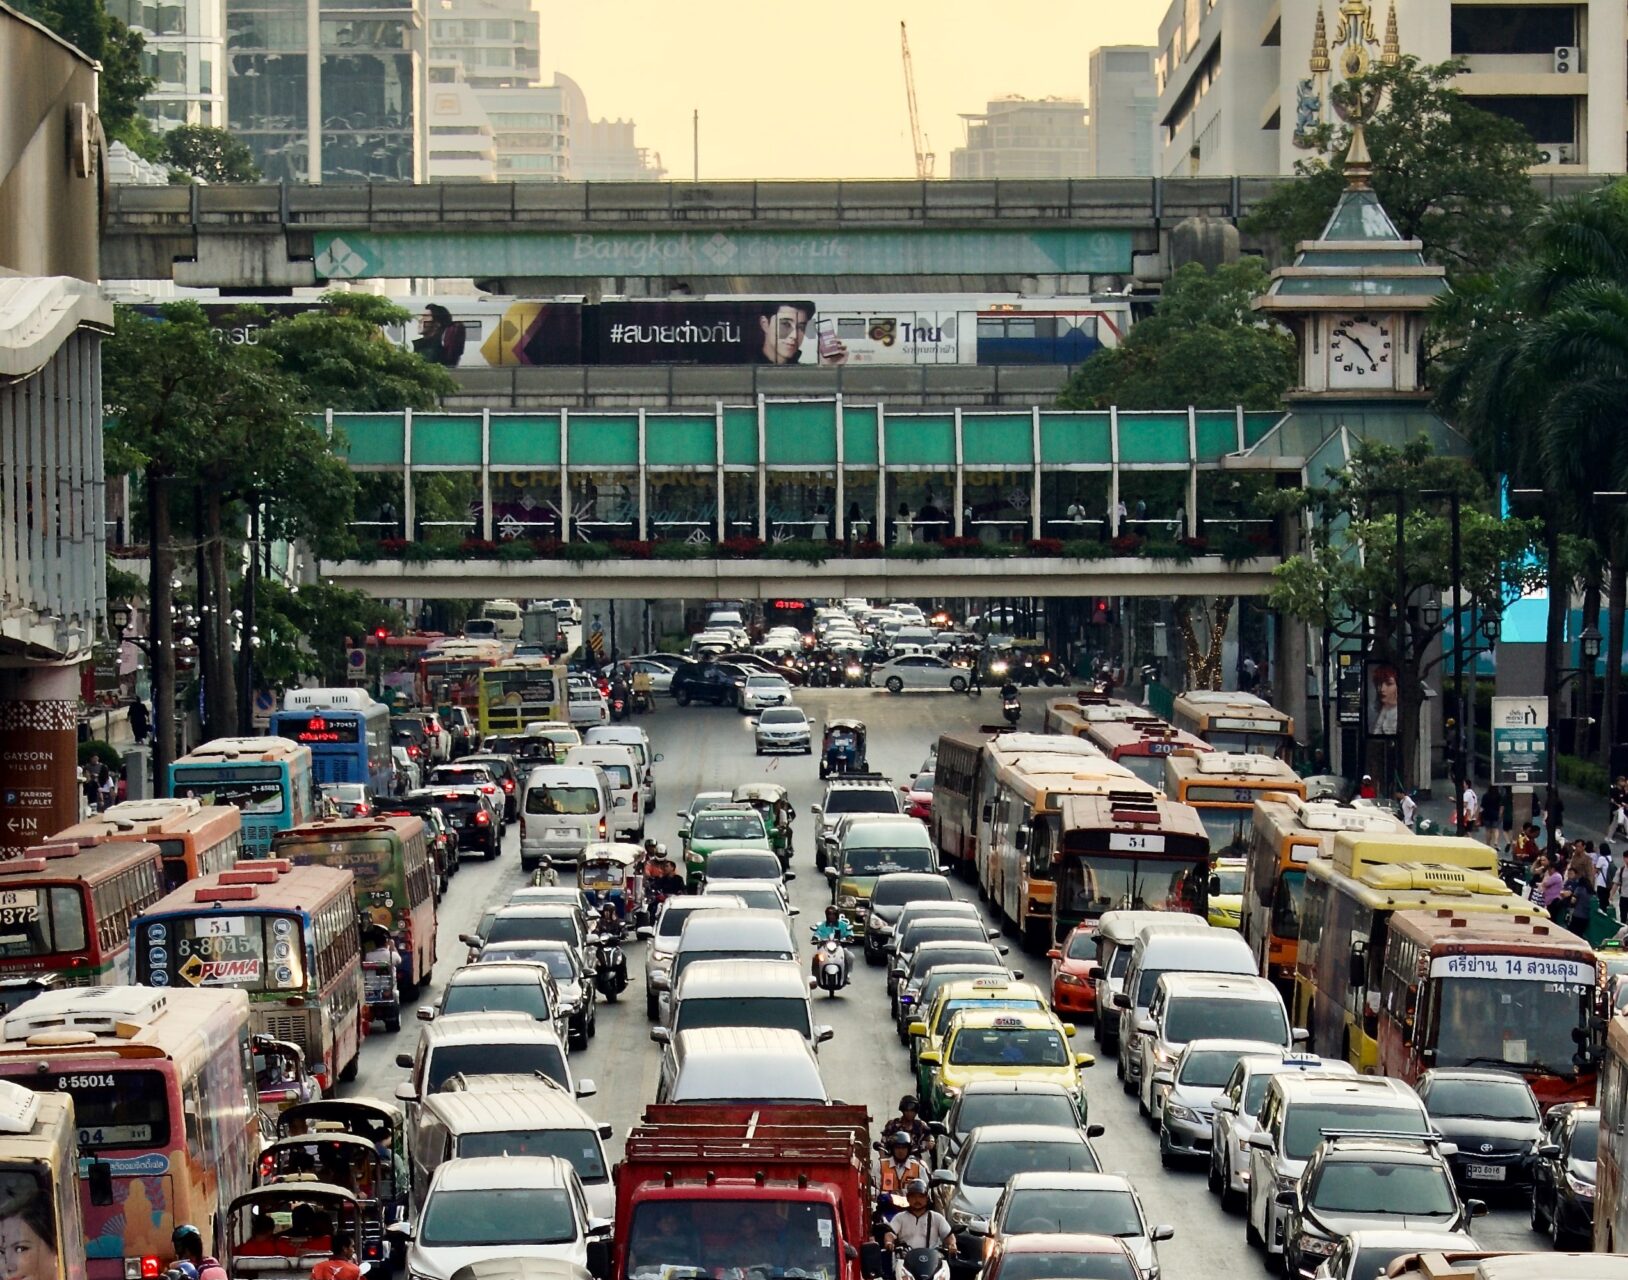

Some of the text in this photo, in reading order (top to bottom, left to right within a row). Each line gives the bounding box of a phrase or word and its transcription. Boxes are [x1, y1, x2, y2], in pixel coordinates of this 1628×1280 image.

[573, 233, 696, 268] Bangkok
[788, 240, 806, 257] of
[811, 239, 849, 257] Life
[610, 320, 741, 343] #สบายต่างกัน
[900, 323, 941, 342] ไทย
[4, 752, 53, 761] GAYSORN
[21, 817, 37, 829] IN
[330, 843, 343, 853] 74
[200, 959, 259, 978] PUMA
[1448, 956, 1502, 974] ศรีย่าน
[1506, 960, 1527, 974] 14
[1552, 984, 1588, 995] 14-42
[58, 1075, 115, 1089] 8-55014
